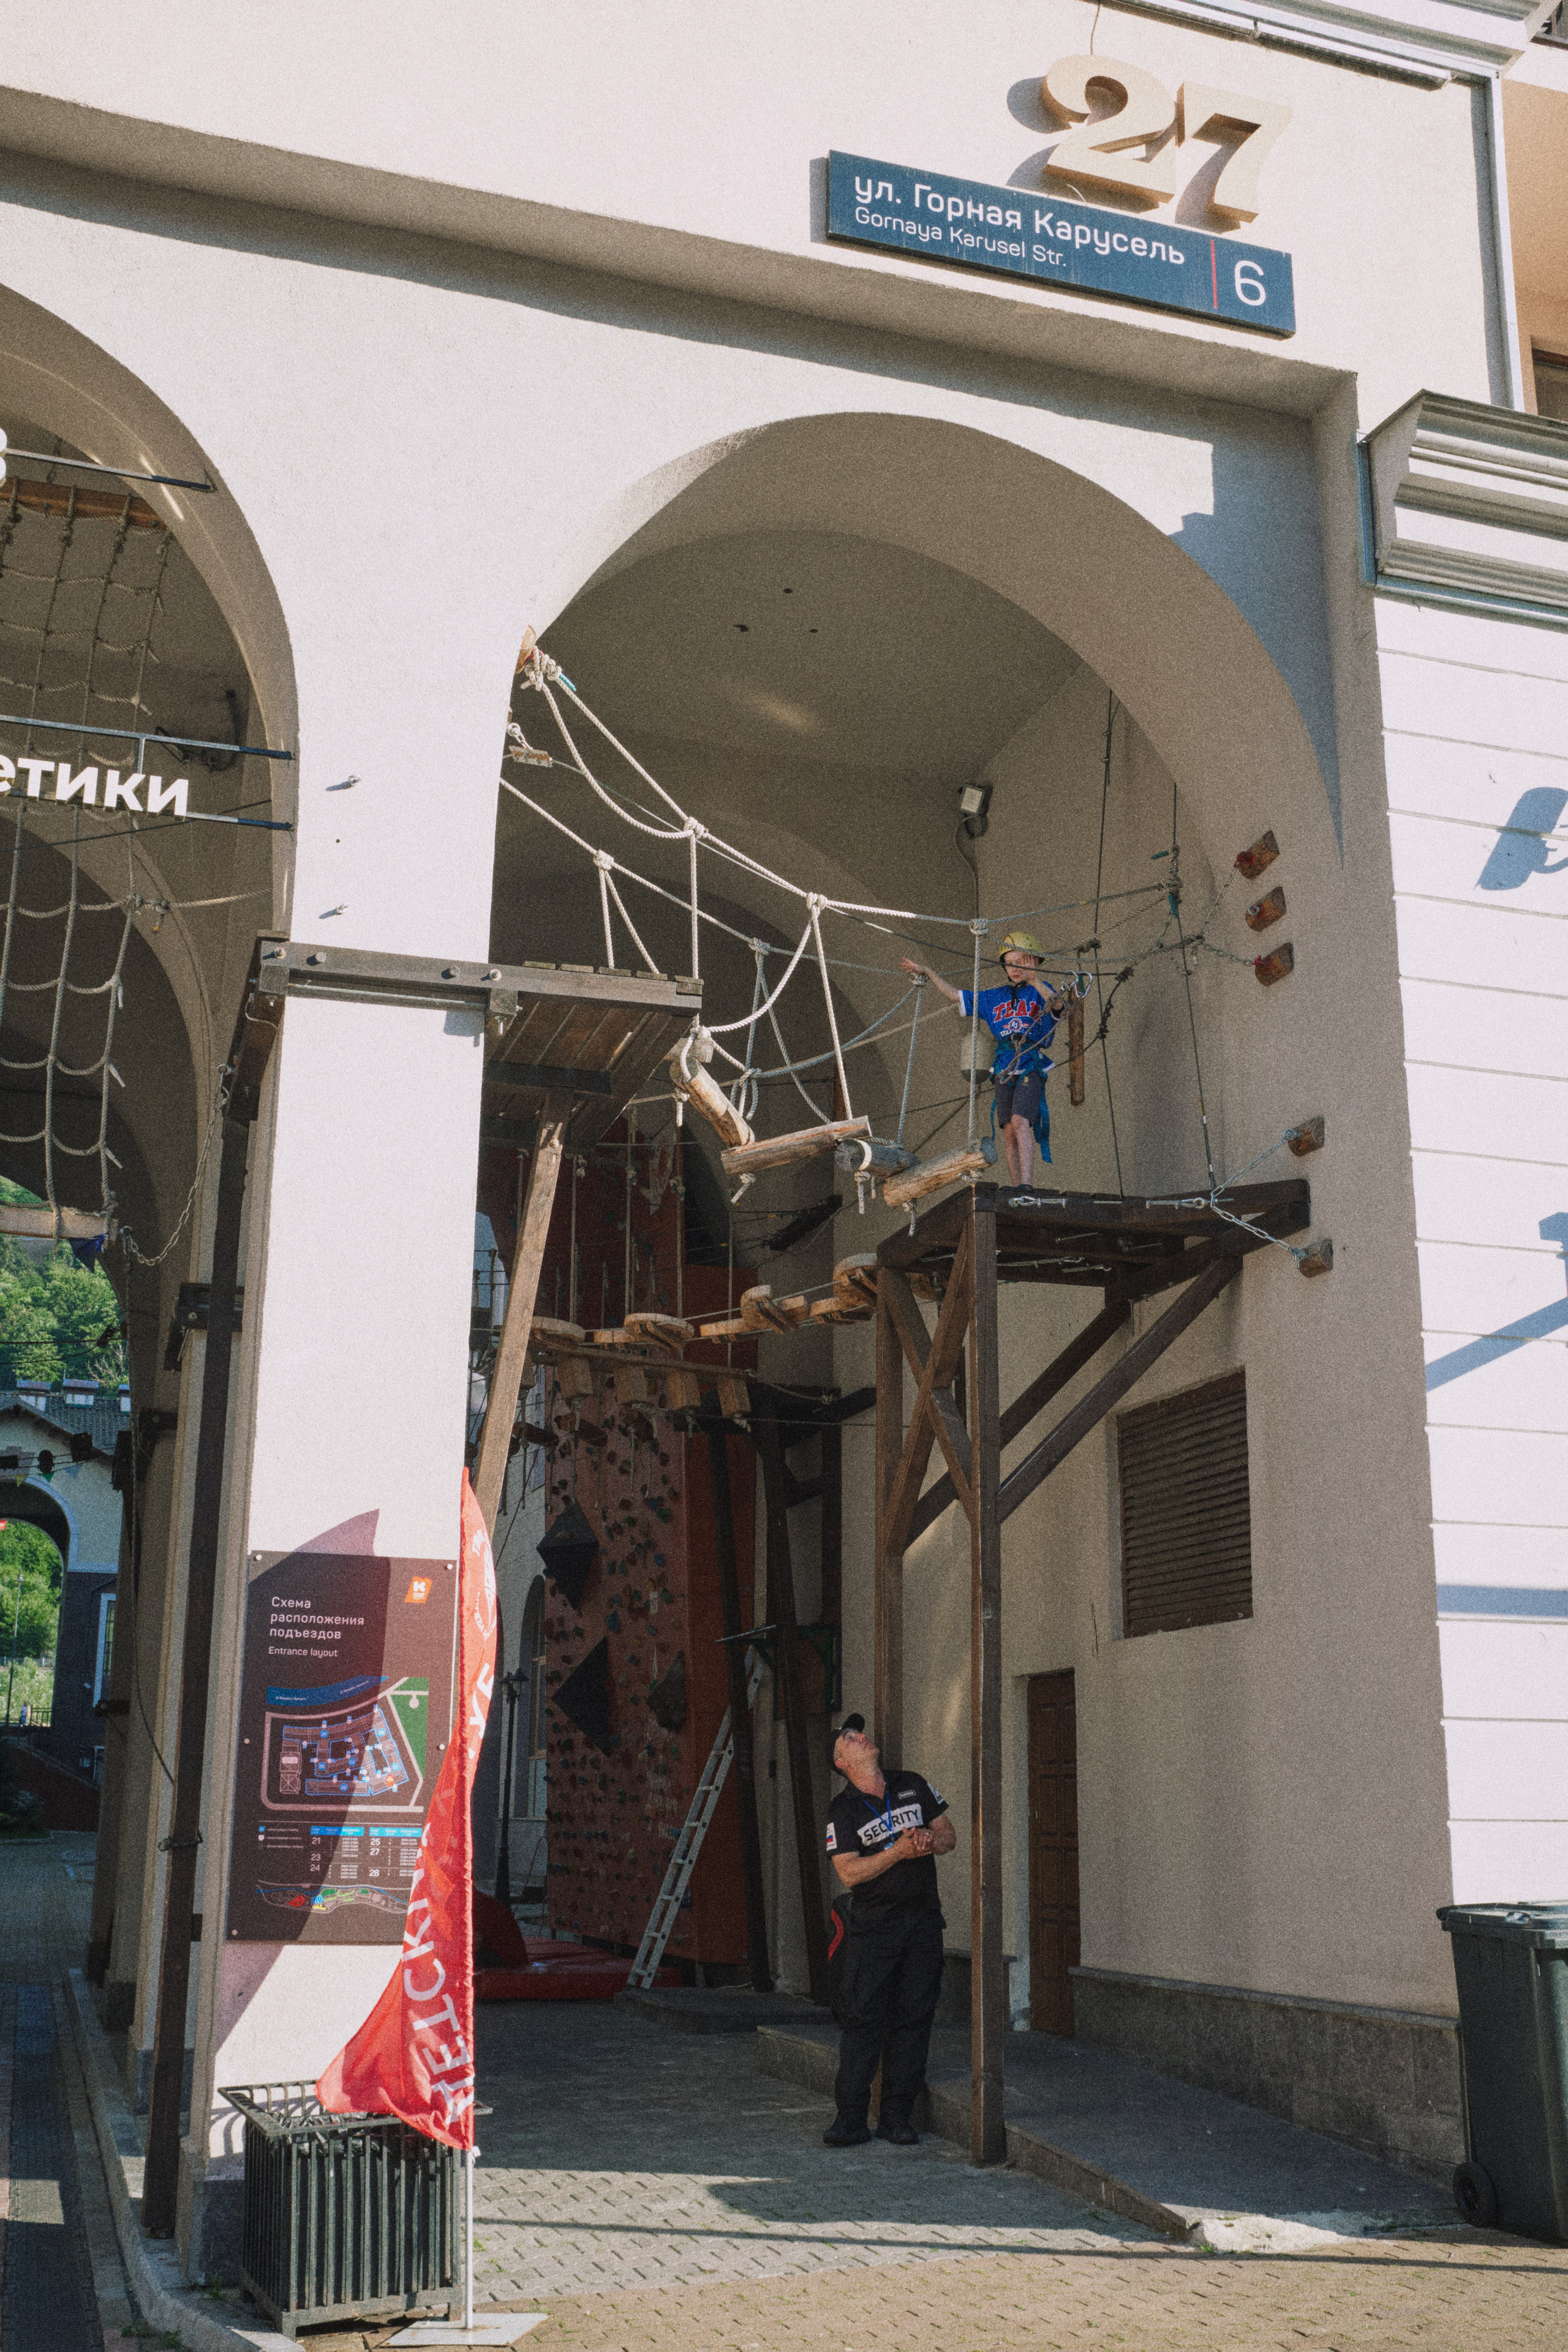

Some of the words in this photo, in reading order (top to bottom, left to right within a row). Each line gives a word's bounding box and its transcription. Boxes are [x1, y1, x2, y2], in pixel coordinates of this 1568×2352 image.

[1042, 54, 1294, 223] 27
[855, 176, 901, 203] ул.
[915, 183, 1021, 230] Горная
[1035, 209, 1185, 265] Карусель
[855, 206, 942, 242] Gornaya
[950, 227, 1025, 258] Karusel
[1033, 245, 1067, 267] Str.
[1234, 260, 1266, 306] 6
[271, 1596, 311, 1608] Схема
[270, 1613, 364, 1626] расположения
[270, 1627, 341, 1640] подъездов
[268, 1646, 307, 1656] Entrance
[310, 1648, 338, 1659] layout
